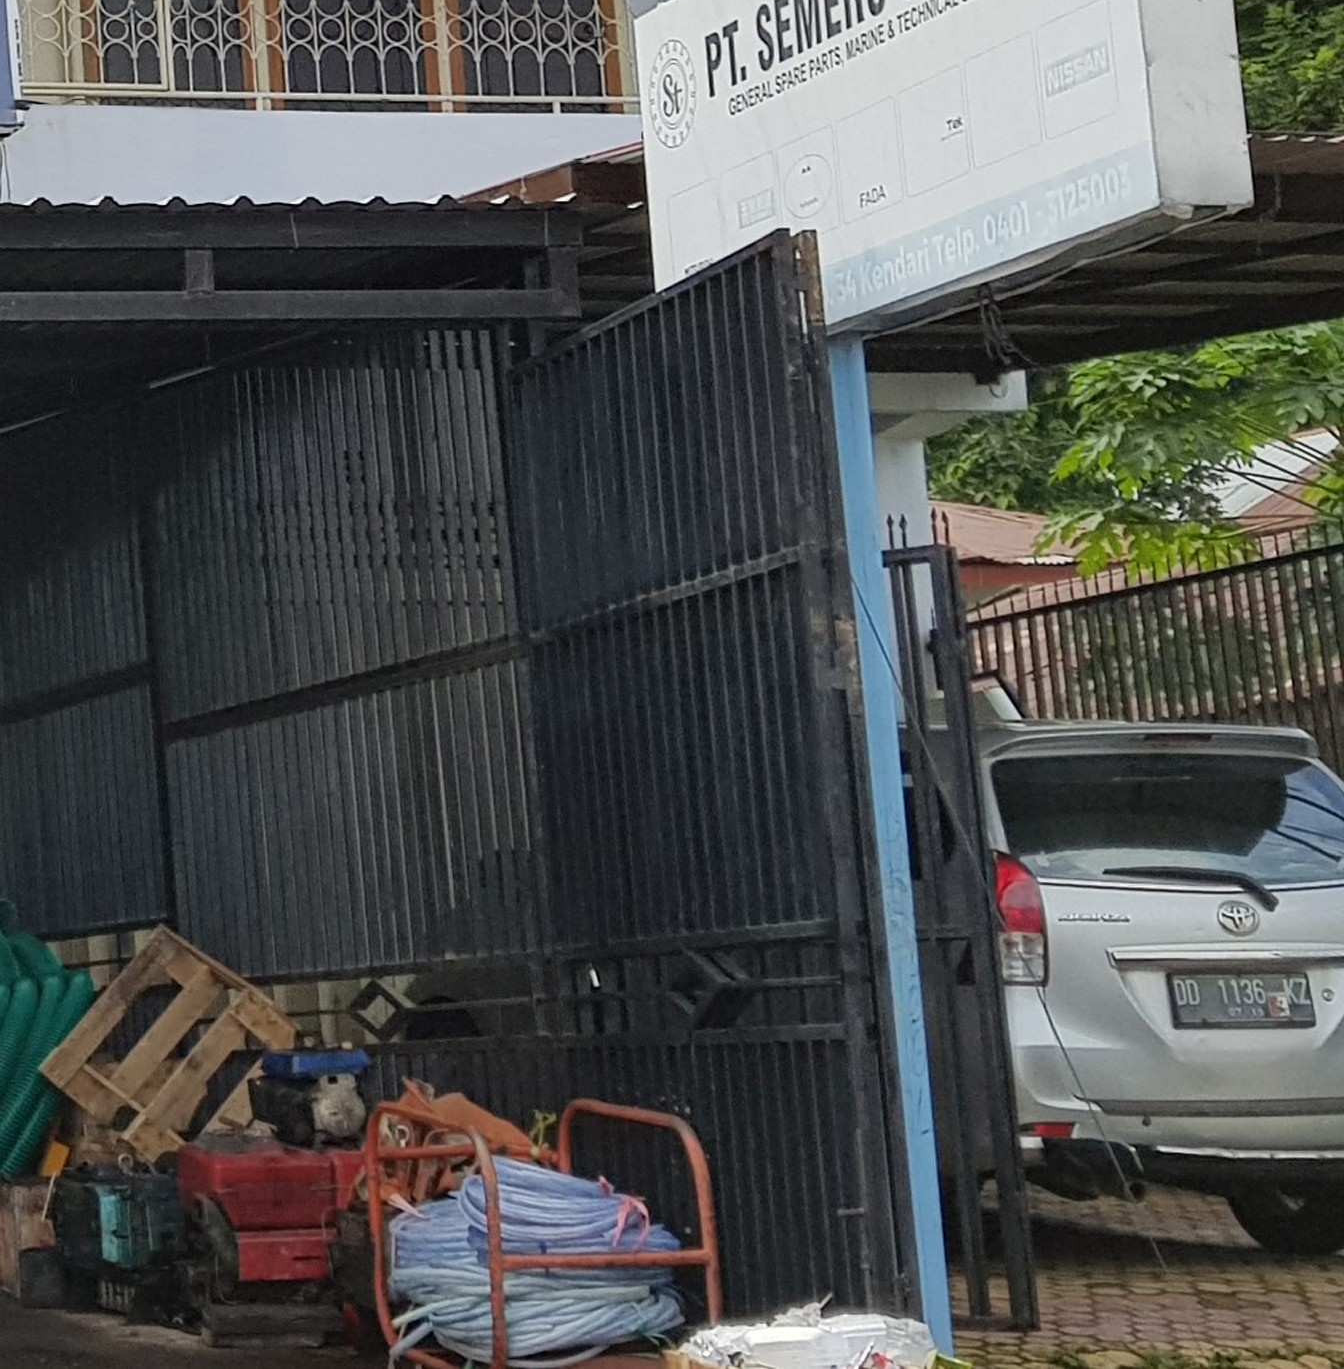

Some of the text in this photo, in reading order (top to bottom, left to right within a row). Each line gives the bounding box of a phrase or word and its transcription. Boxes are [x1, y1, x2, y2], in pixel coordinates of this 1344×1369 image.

[704, 19, 748, 99] PT.
[727, 83, 775, 116] GENERAL
[775, 64, 807, 96] SPARE
[809, 47, 845, 80] PARTS,
[846, 26, 885, 61] MARINE
[1045, 44, 1110, 94] NISSAN
[859, 185, 887, 208] FADA
[859, 238, 930, 293] Kendari
[983, 200, 1031, 244] 0401
[1173, 978, 1312, 1006] DD 1136 KZ
